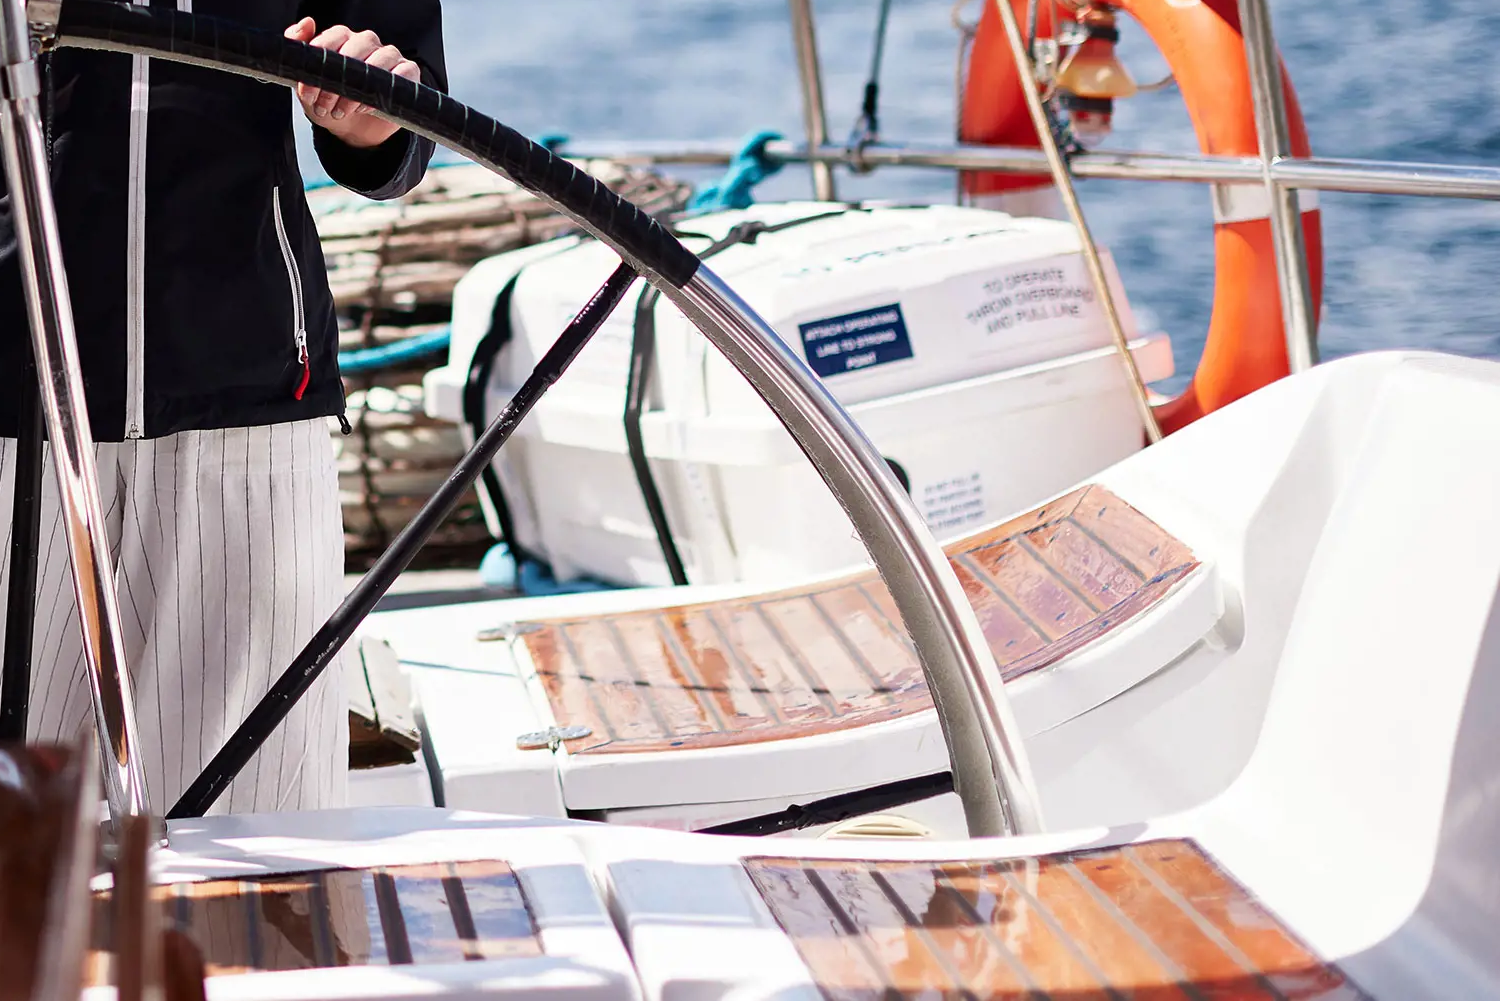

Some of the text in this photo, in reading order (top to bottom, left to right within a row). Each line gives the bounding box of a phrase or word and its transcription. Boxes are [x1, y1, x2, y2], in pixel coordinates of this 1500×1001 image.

[982, 267, 1065, 294] TO OPERATE
[965, 296, 1013, 325] THROW
[985, 313, 1014, 335] AND
[1016, 306, 1048, 323] PULL
[841, 338, 856, 351] TO
